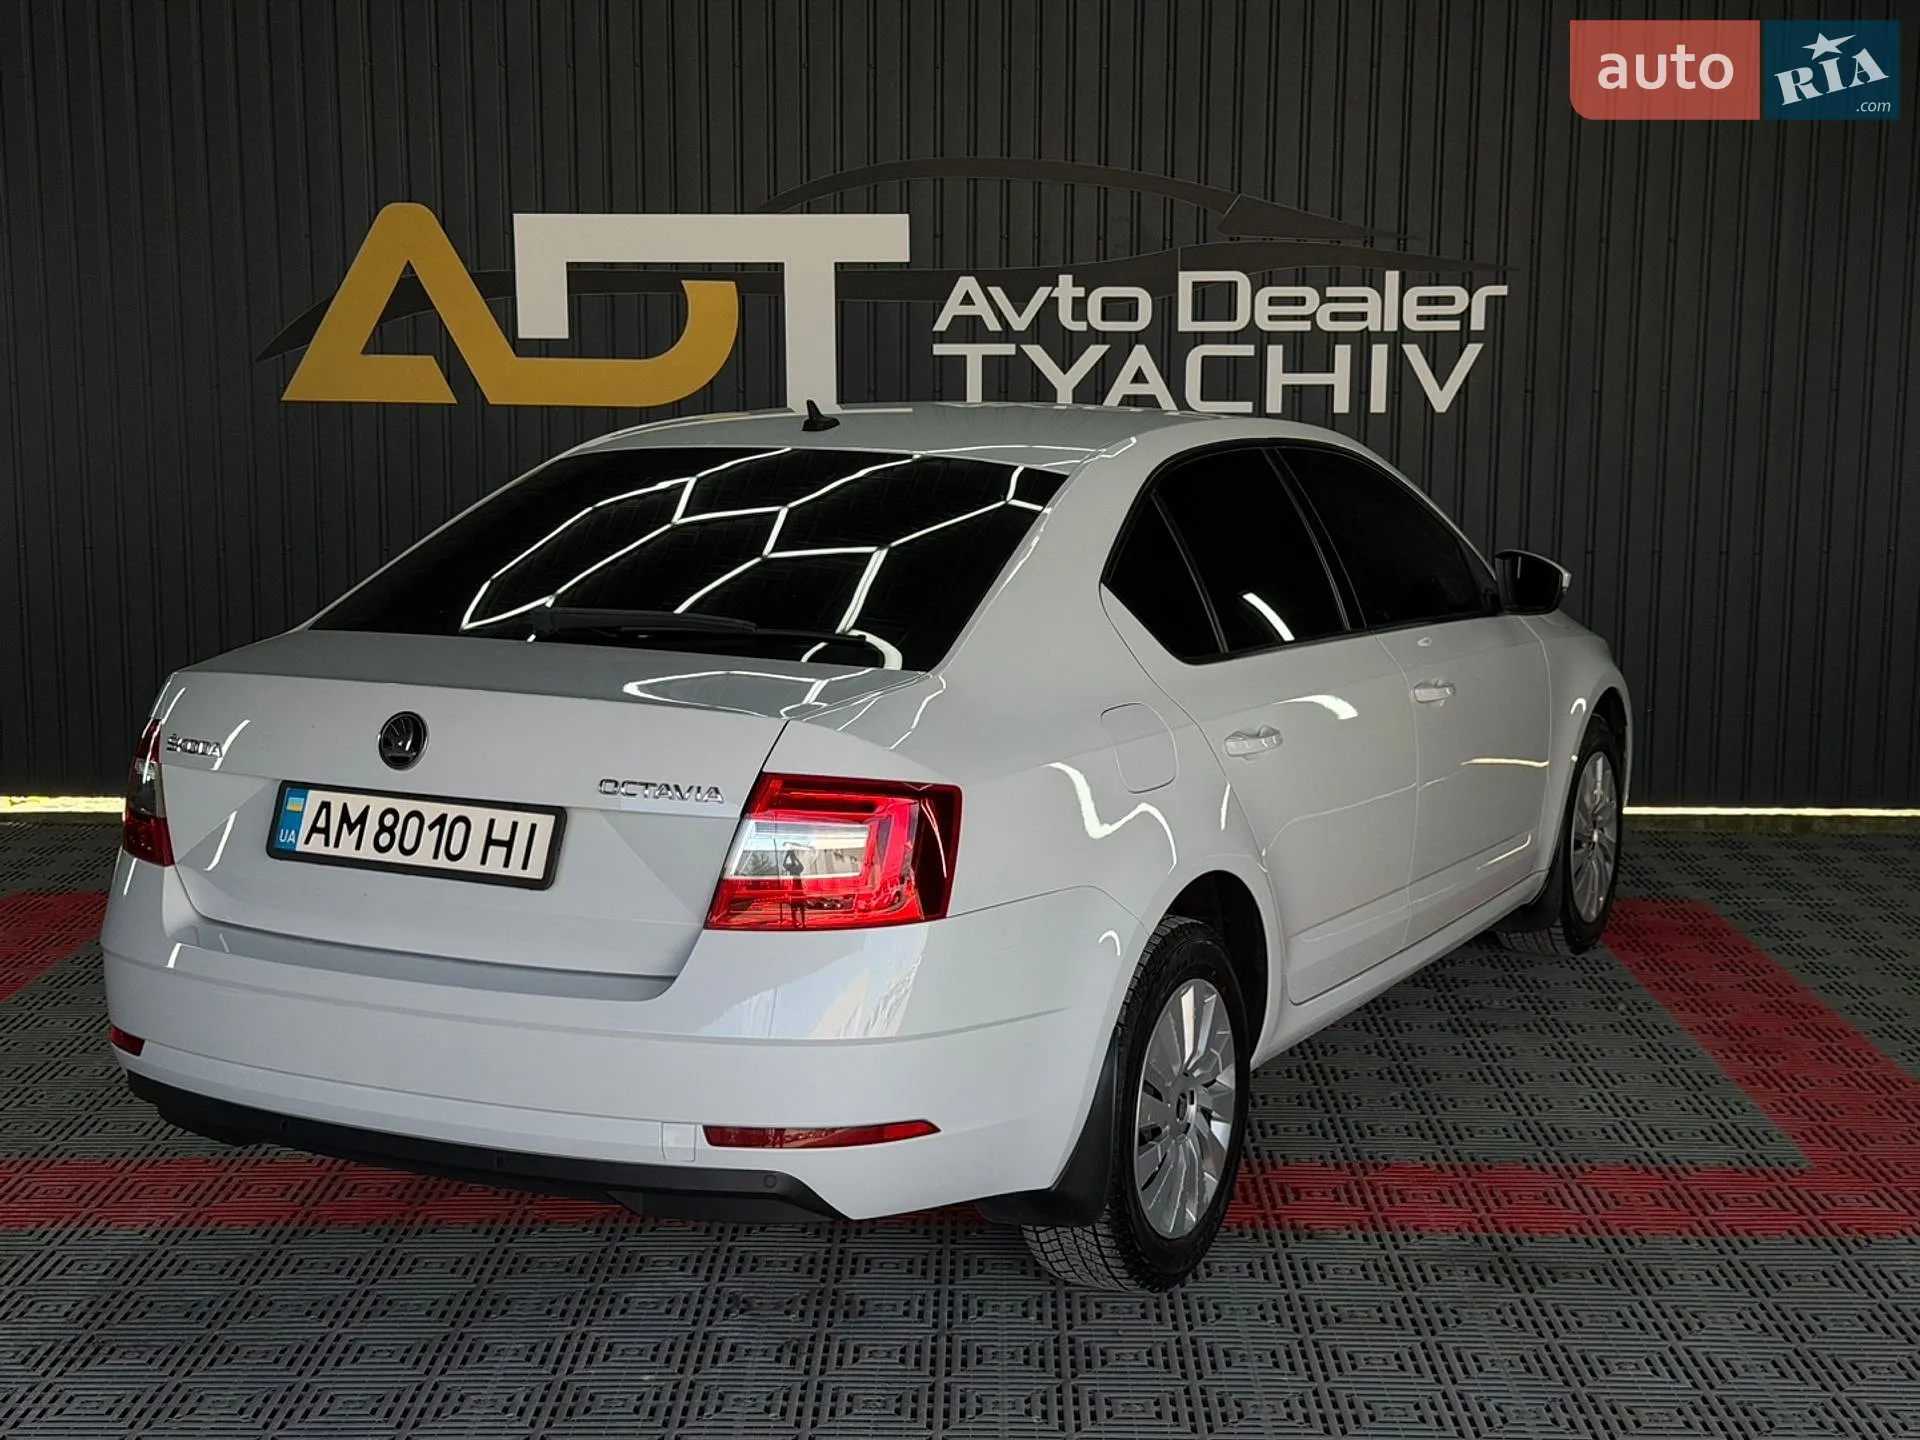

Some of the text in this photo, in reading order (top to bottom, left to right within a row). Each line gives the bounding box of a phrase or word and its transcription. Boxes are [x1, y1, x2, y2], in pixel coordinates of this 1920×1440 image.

[280, 202, 911, 413] ADT
[932, 270, 1509, 332] Avto Dealer
[932, 343, 1485, 414] TYACHIV
[598, 779, 724, 803] OCTAVIA
[279, 827, 297, 844] UA
[303, 800, 538, 871] AM 8010 HI
